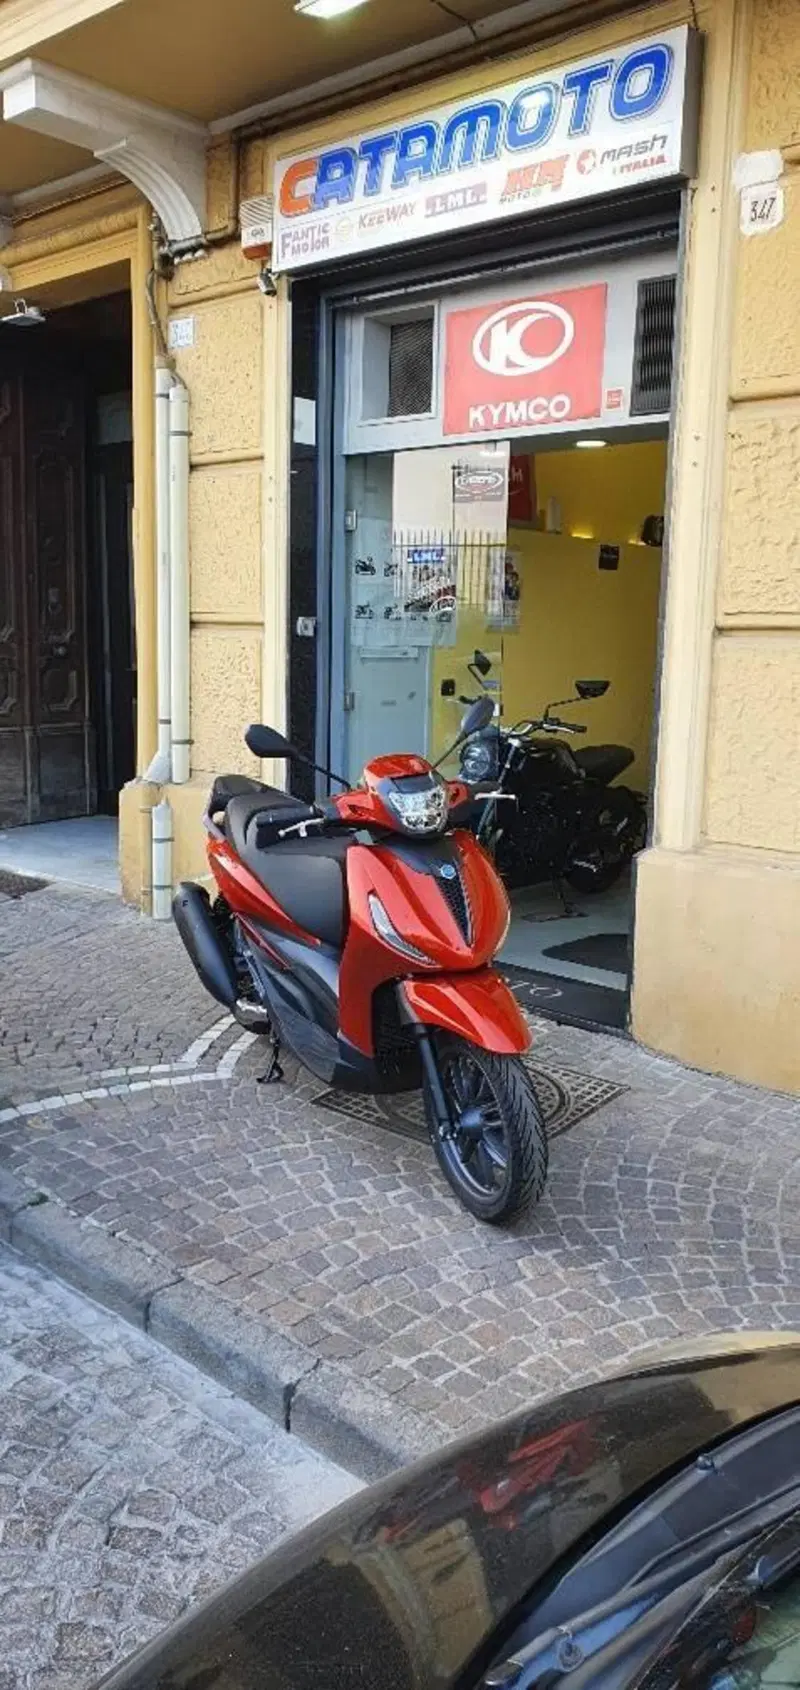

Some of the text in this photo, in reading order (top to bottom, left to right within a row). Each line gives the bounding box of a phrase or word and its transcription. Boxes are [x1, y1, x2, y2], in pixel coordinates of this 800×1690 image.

[279, 43, 674, 217] CATAMOTO
[600, 134, 668, 165] MASH
[750, 197, 776, 221] 347
[280, 222, 330, 257] FANTIC
[290, 235, 330, 257] MOTOR
[468, 394, 571, 428] KYMCO
